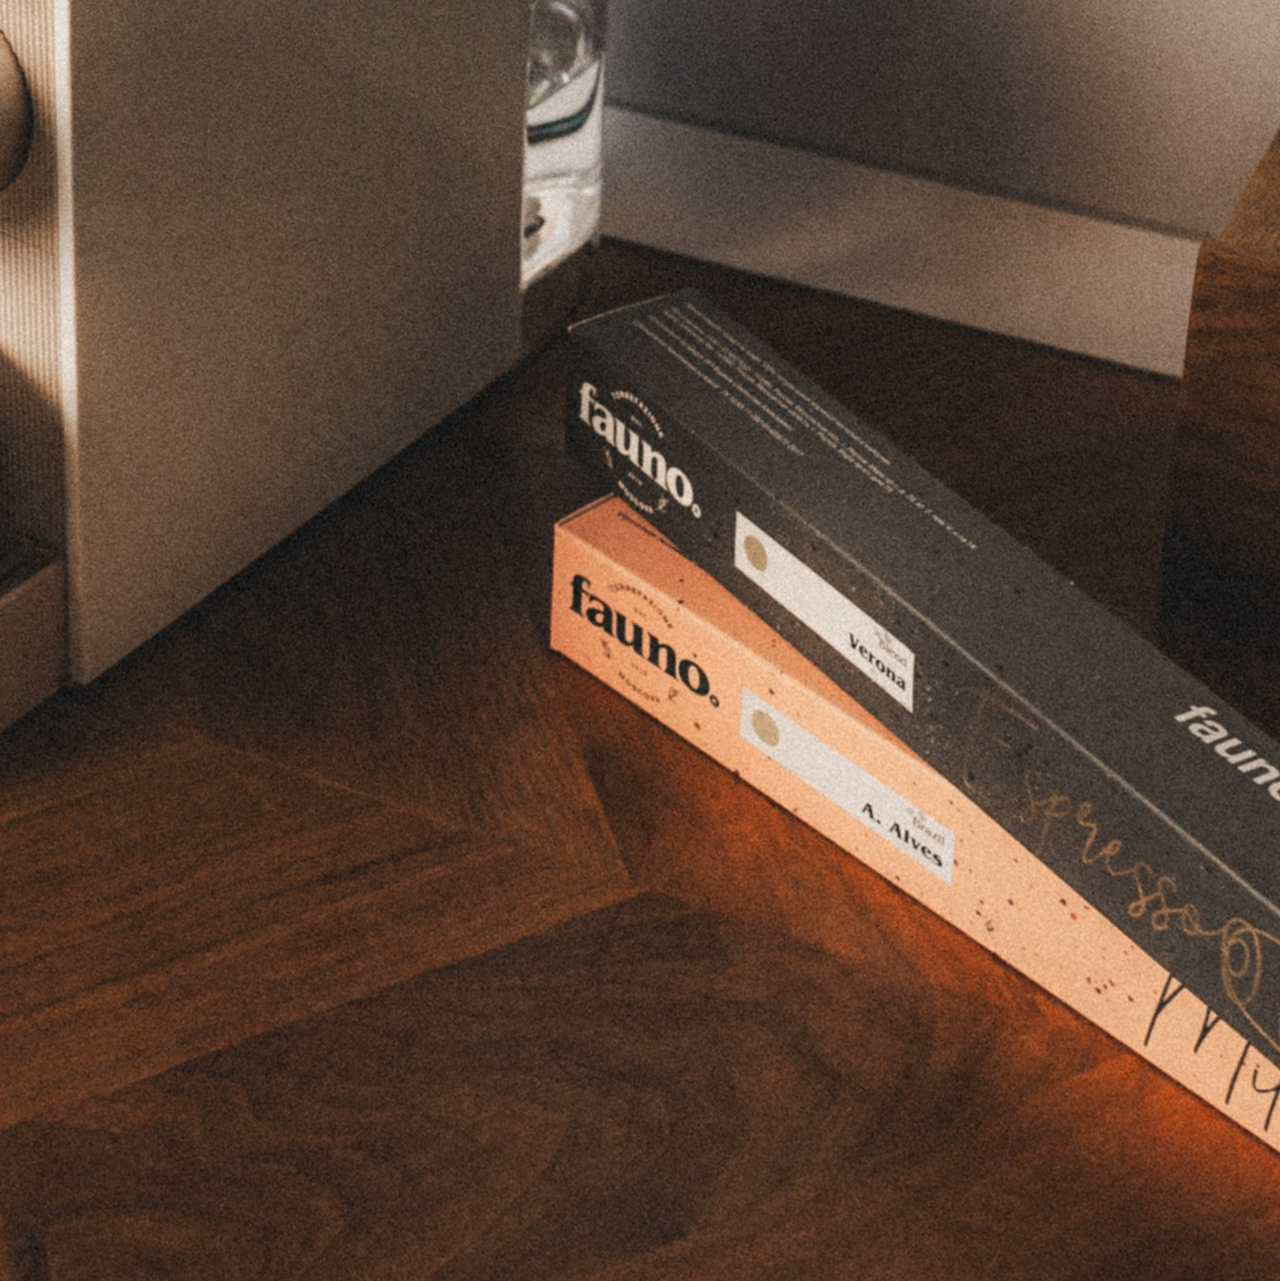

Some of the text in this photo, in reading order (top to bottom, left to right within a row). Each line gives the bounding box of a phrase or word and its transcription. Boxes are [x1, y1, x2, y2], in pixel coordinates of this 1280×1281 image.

[847, 631, 908, 692] Verona
[860, 802, 945, 870] A. Alves
